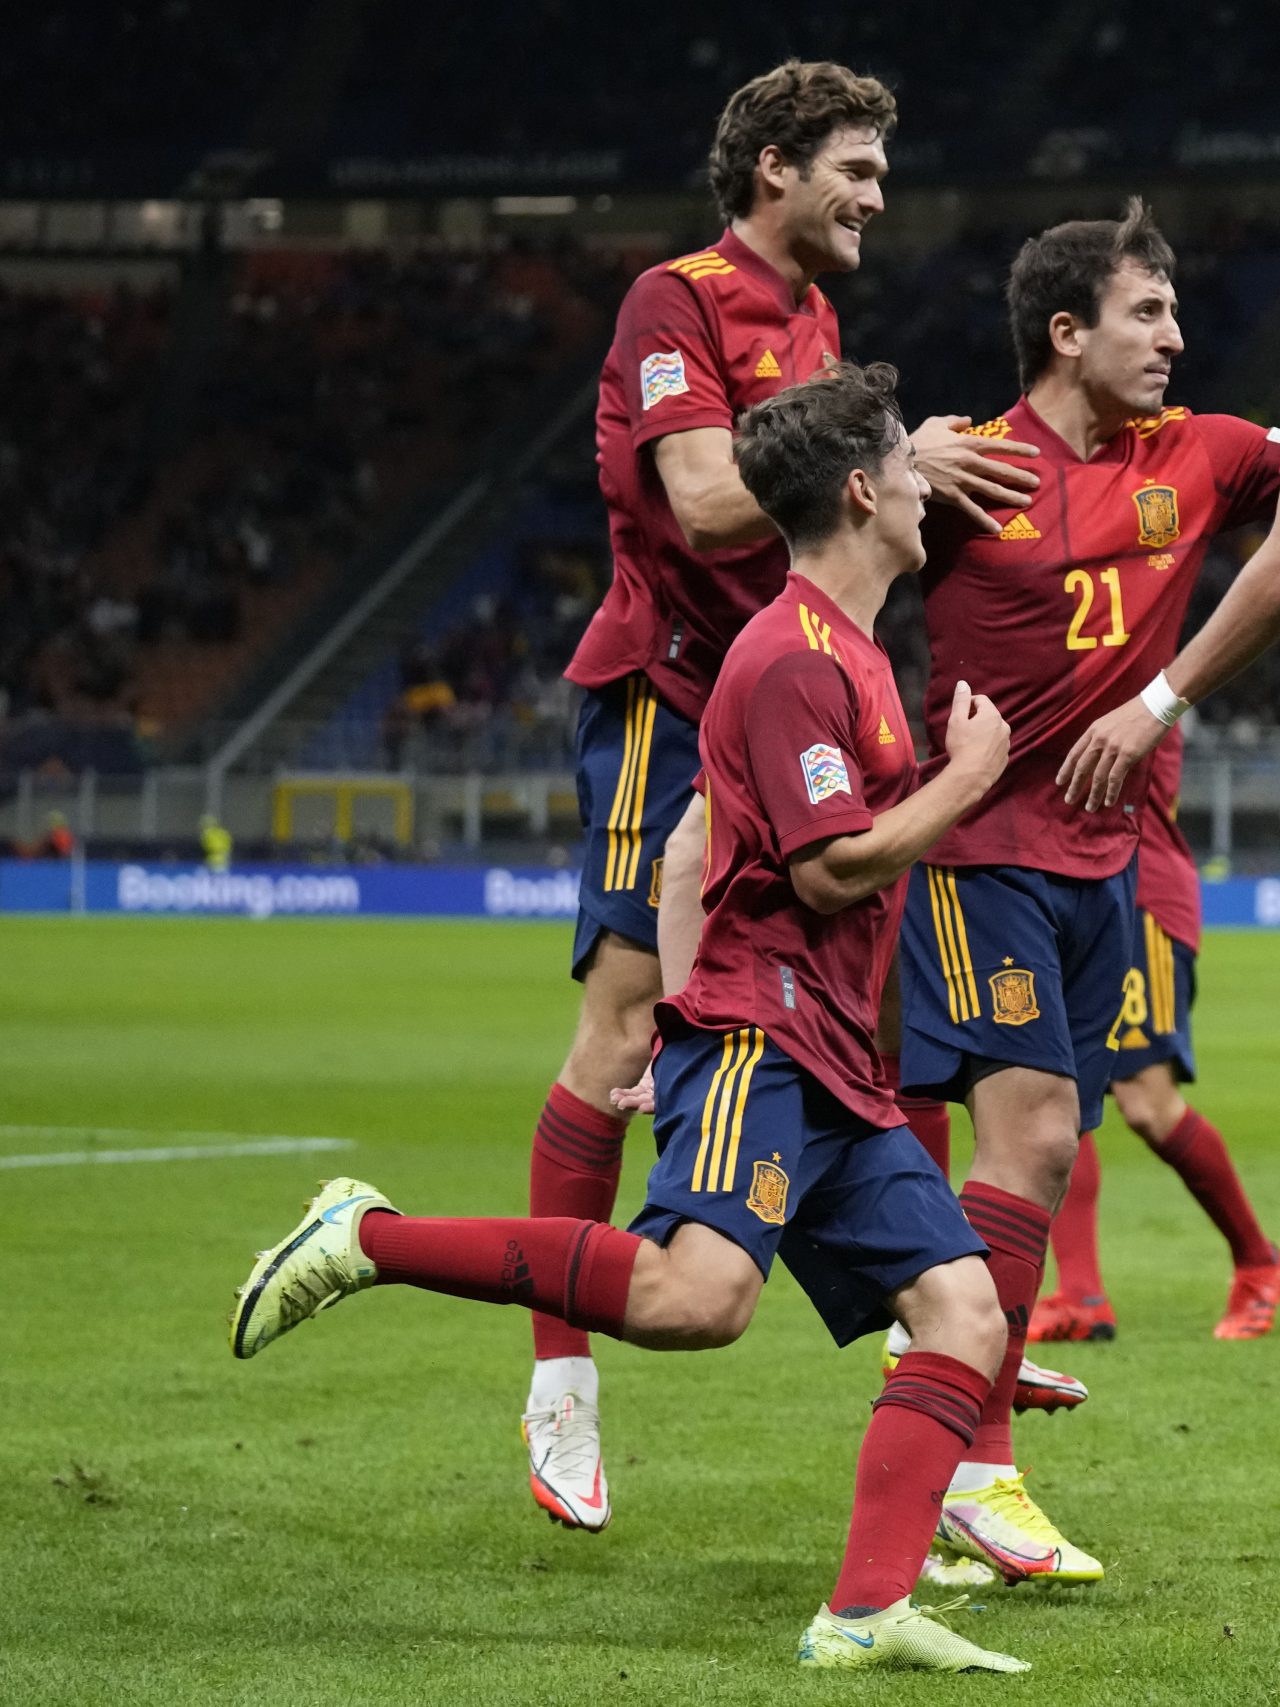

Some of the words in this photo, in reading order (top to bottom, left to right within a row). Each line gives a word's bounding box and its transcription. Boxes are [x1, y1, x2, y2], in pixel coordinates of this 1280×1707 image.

[999, 528, 1041, 540] adidas
[1064, 567, 1131, 650] 21
[484, 868, 581, 915] Book
[1124, 967, 1148, 1026] 8
